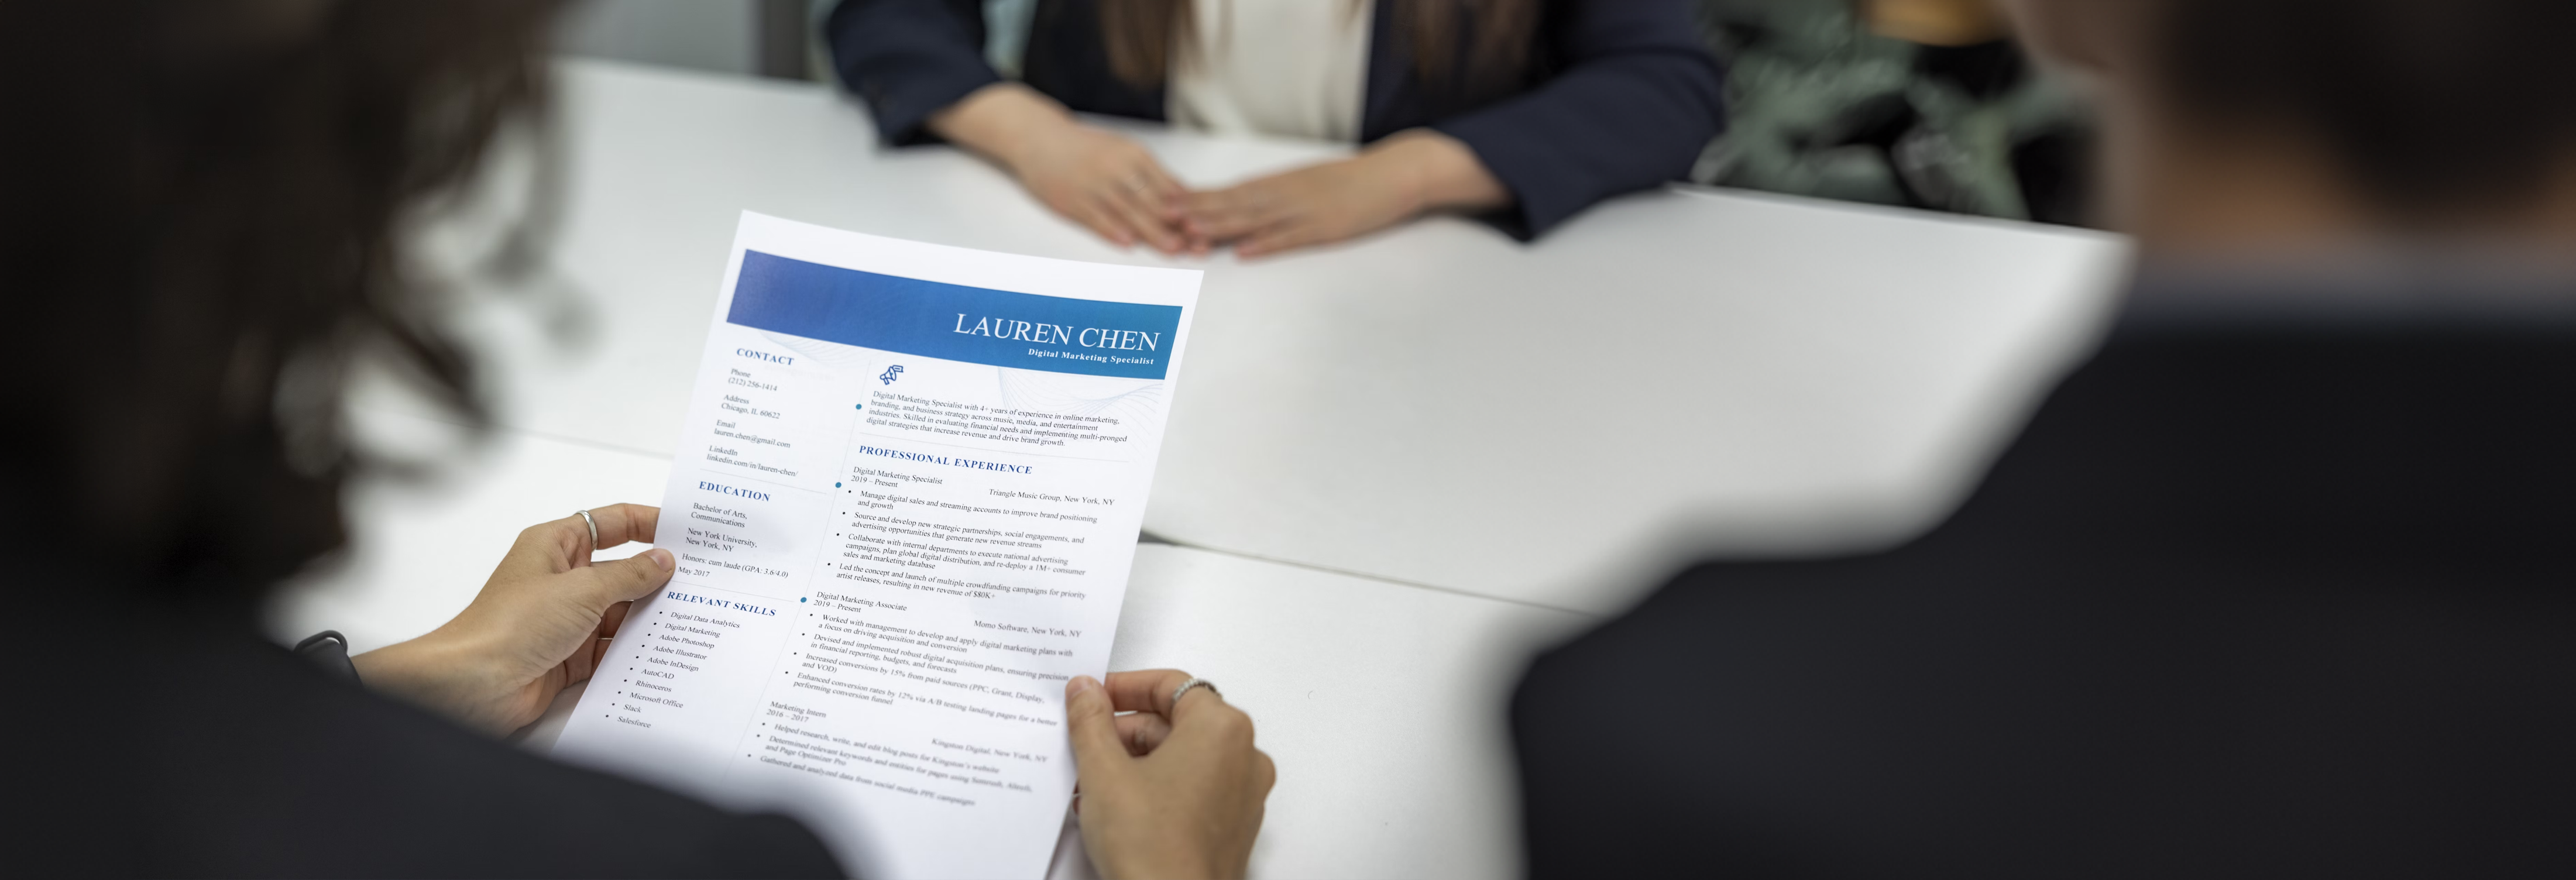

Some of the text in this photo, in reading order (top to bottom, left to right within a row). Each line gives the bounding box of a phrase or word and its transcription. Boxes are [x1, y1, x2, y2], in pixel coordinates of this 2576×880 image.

[953, 313, 1160, 351] LAUREN CHEN
[736, 348, 794, 365] CONTACT
[1028, 348, 1154, 365] Digital Marketing Specialist
[730, 368, 751, 377] Phone
[727, 377, 778, 391] (212) 256-1414
[723, 394, 749, 404] Address
[873, 390, 896, 400] Digital
[896, 394, 930, 406] Marketing
[931, 399, 963, 409] Specialist
[720, 402, 749, 414] Chicago,
[759, 410, 781, 419] 60622
[870, 398, 901, 411] branding,
[915, 405, 943, 415] business
[943, 411, 970, 420] strategy
[992, 417, 1014, 425] music,
[716, 419, 736, 428] Email
[865, 417, 887, 425] digital
[888, 421, 919, 430] strategies
[933, 426, 960, 435] increase
[868, 407, 901, 418] industries.
[902, 413, 926, 422] Skilled
[935, 418, 968, 429] evaluating
[970, 421, 999, 431] financial
[1033, 428, 1079, 439] implementing
[1079, 433, 1127, 442] multi-pronged
[713, 428, 791, 448] lauren.chen@gmail.com
[708, 445, 738, 456] LinkedIn
[706, 453, 798, 476] linkedin.com/in/lauren-chen/
[858, 445, 1032, 474] PROFESSIONAL EXPERIENCE
[851, 475, 867, 483] 2019
[874, 478, 898, 487] Present
[853, 466, 943, 484] Digital Marketing Specialist
[699, 481, 770, 501] EDUCATION
[989, 489, 1016, 498] Triangle
[1039, 493, 1062, 502] Group,
[1082, 496, 1100, 504] York,
[692, 502, 722, 513] Bachelor
[731, 510, 747, 519] Arts,
[860, 490, 886, 501] Manage
[887, 494, 908, 503] digital
[939, 502, 971, 512] streaming
[1011, 508, 1038, 517] improve
[1059, 514, 1097, 524] positioning
[691, 511, 745, 528] Communications
[685, 537, 734, 552] New York, NY
[687, 527, 757, 548] New York University,
[678, 566, 692, 575] May
[681, 553, 707, 563] Honors:
[723, 561, 741, 569] laude
[741, 565, 763, 573] (GPA:
[763, 568, 788, 578] 3.6/4.0)
[873, 556, 906, 566] marketing
[906, 559, 936, 569] database
[667, 591, 776, 616] RELEVANT SKILLS
[816, 591, 907, 611] Digital Marketing Associate
[837, 603, 861, 613] Present
[670, 611, 693, 620] Digital
[709, 618, 740, 628] Analytics
[664, 623, 720, 638] Digital Marketing
[973, 620, 996, 628] Momo
[997, 623, 1029, 633] Software,
[1049, 628, 1067, 637] York,
[681, 637, 715, 649] Photoshop
[652, 645, 707, 659] Adobe Illustrator
[818, 643, 848, 654] financial
[848, 650, 881, 661] reporting,
[882, 654, 911, 666] budgets,
[926, 662, 957, 673] forecasts
[646, 656, 699, 672] Adobe InDesign
[817, 663, 837, 673] VOD)
[640, 668, 674, 679] AutoCAD
[635, 680, 672, 692] Rhinoceros
[792, 681, 894, 704] performing conversion funnel
[623, 704, 641, 713] Slack
[629, 692, 684, 708] Microsoft Office
[765, 708, 784, 717] 2016
[790, 713, 809, 722] 2017
[770, 700, 826, 718] Marketing Intern
[617, 716, 651, 728] Salesforce
